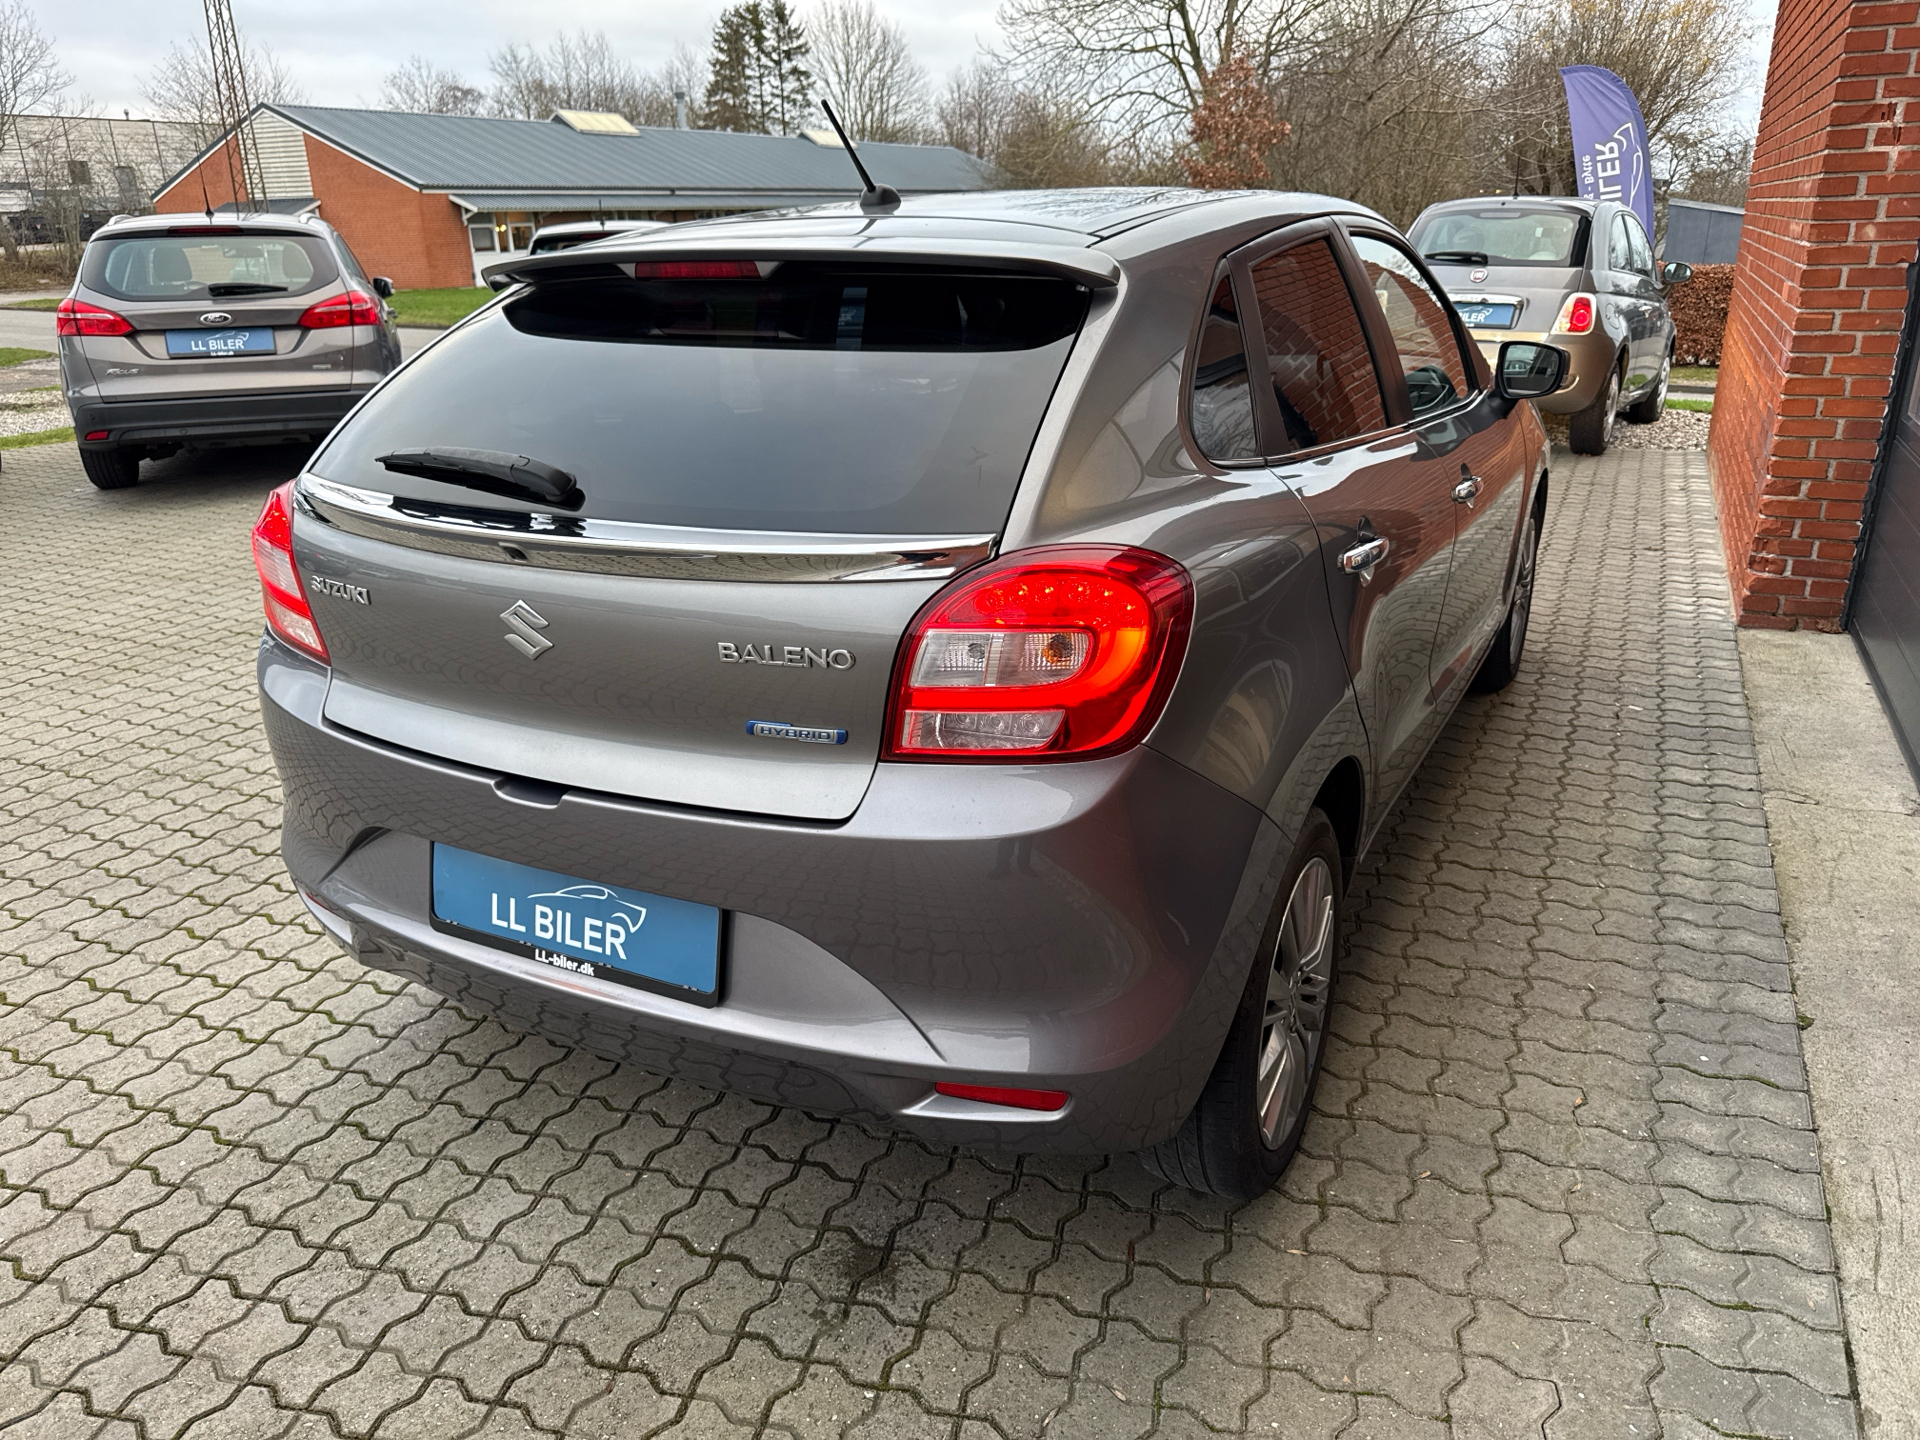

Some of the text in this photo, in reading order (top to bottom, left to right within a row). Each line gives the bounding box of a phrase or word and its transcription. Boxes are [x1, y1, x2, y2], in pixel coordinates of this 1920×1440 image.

[191, 339, 245, 351] LL BILER
[310, 575, 372, 605] SUZUKI
[717, 642, 856, 671] BALENO
[759, 725, 832, 742] HYBRID
[491, 892, 628, 960] LL BILER
[534, 948, 595, 977] LL-biler.dk
